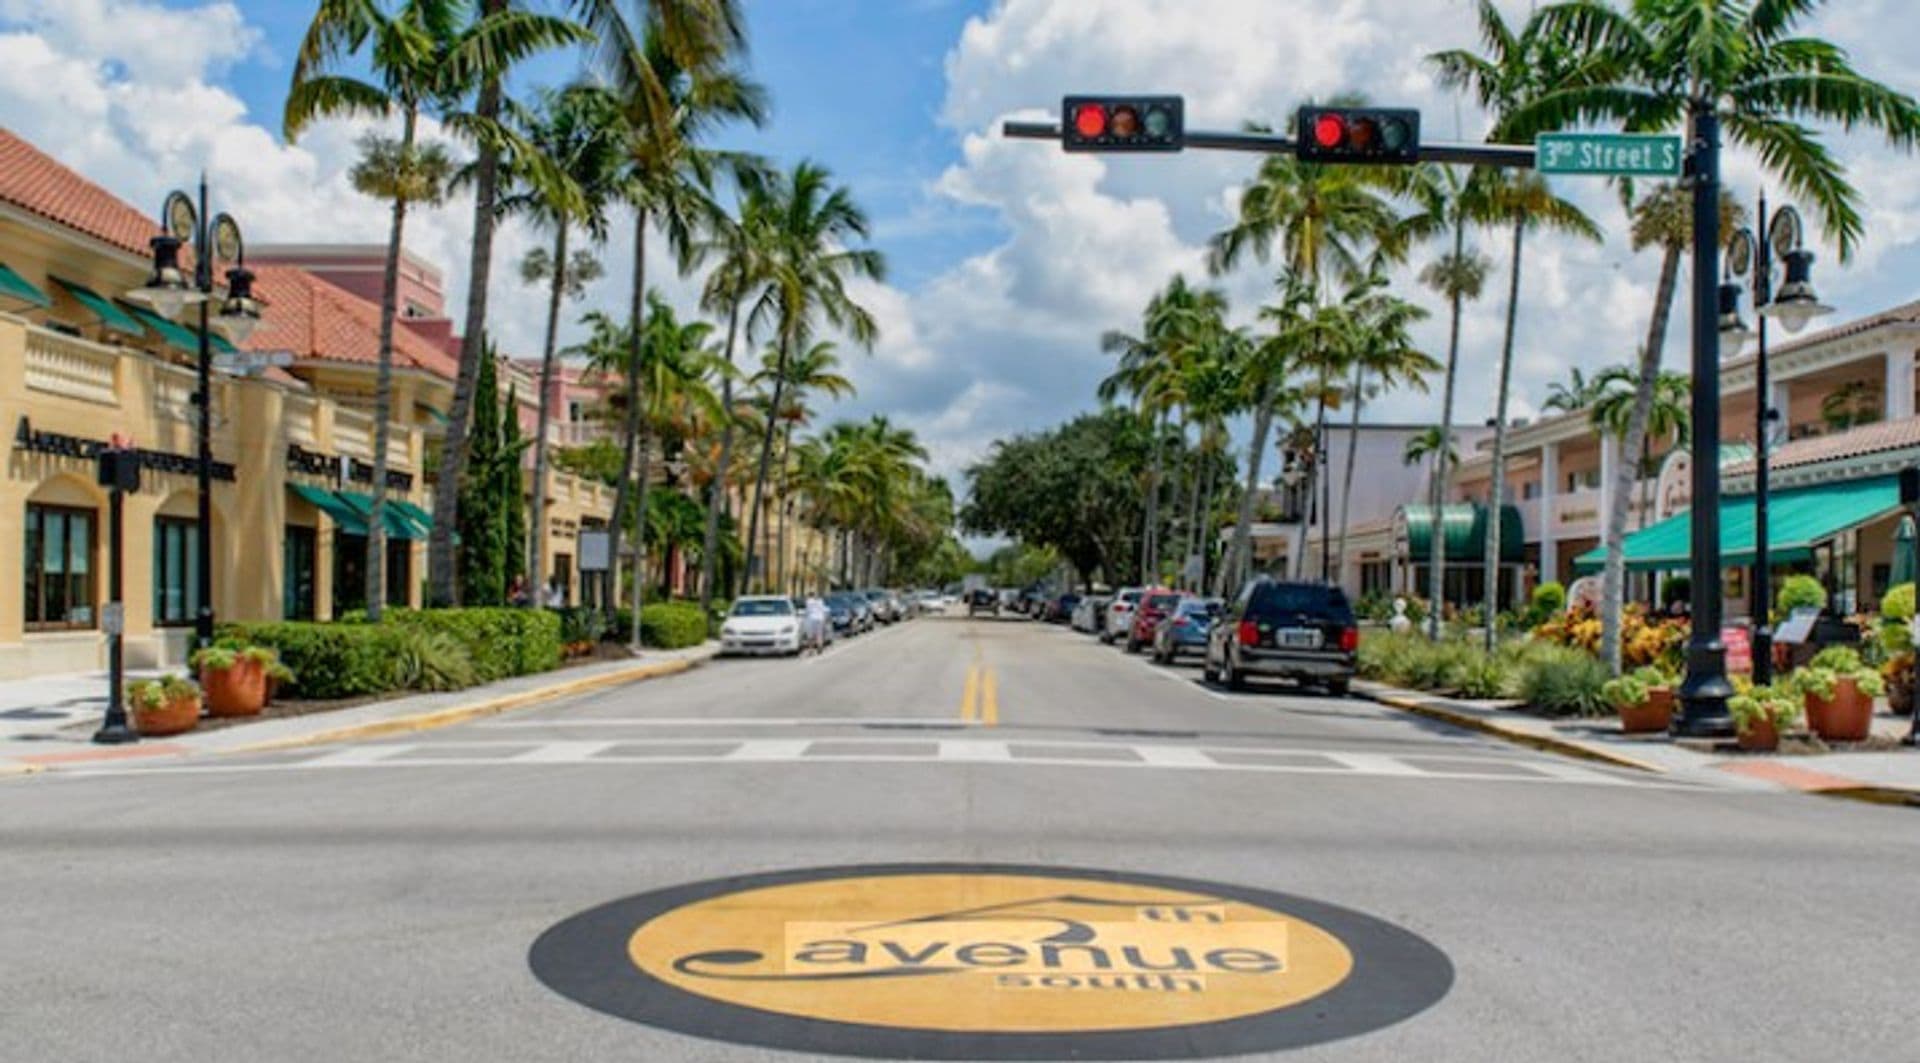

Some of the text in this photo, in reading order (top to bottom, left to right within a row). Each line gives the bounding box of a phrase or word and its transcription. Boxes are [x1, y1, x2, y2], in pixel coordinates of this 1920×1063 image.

[1580, 141, 1650, 169] Street
[1661, 143, 1676, 170] S
[793, 939, 1283, 974] avenue
[996, 974, 1203, 992] south
